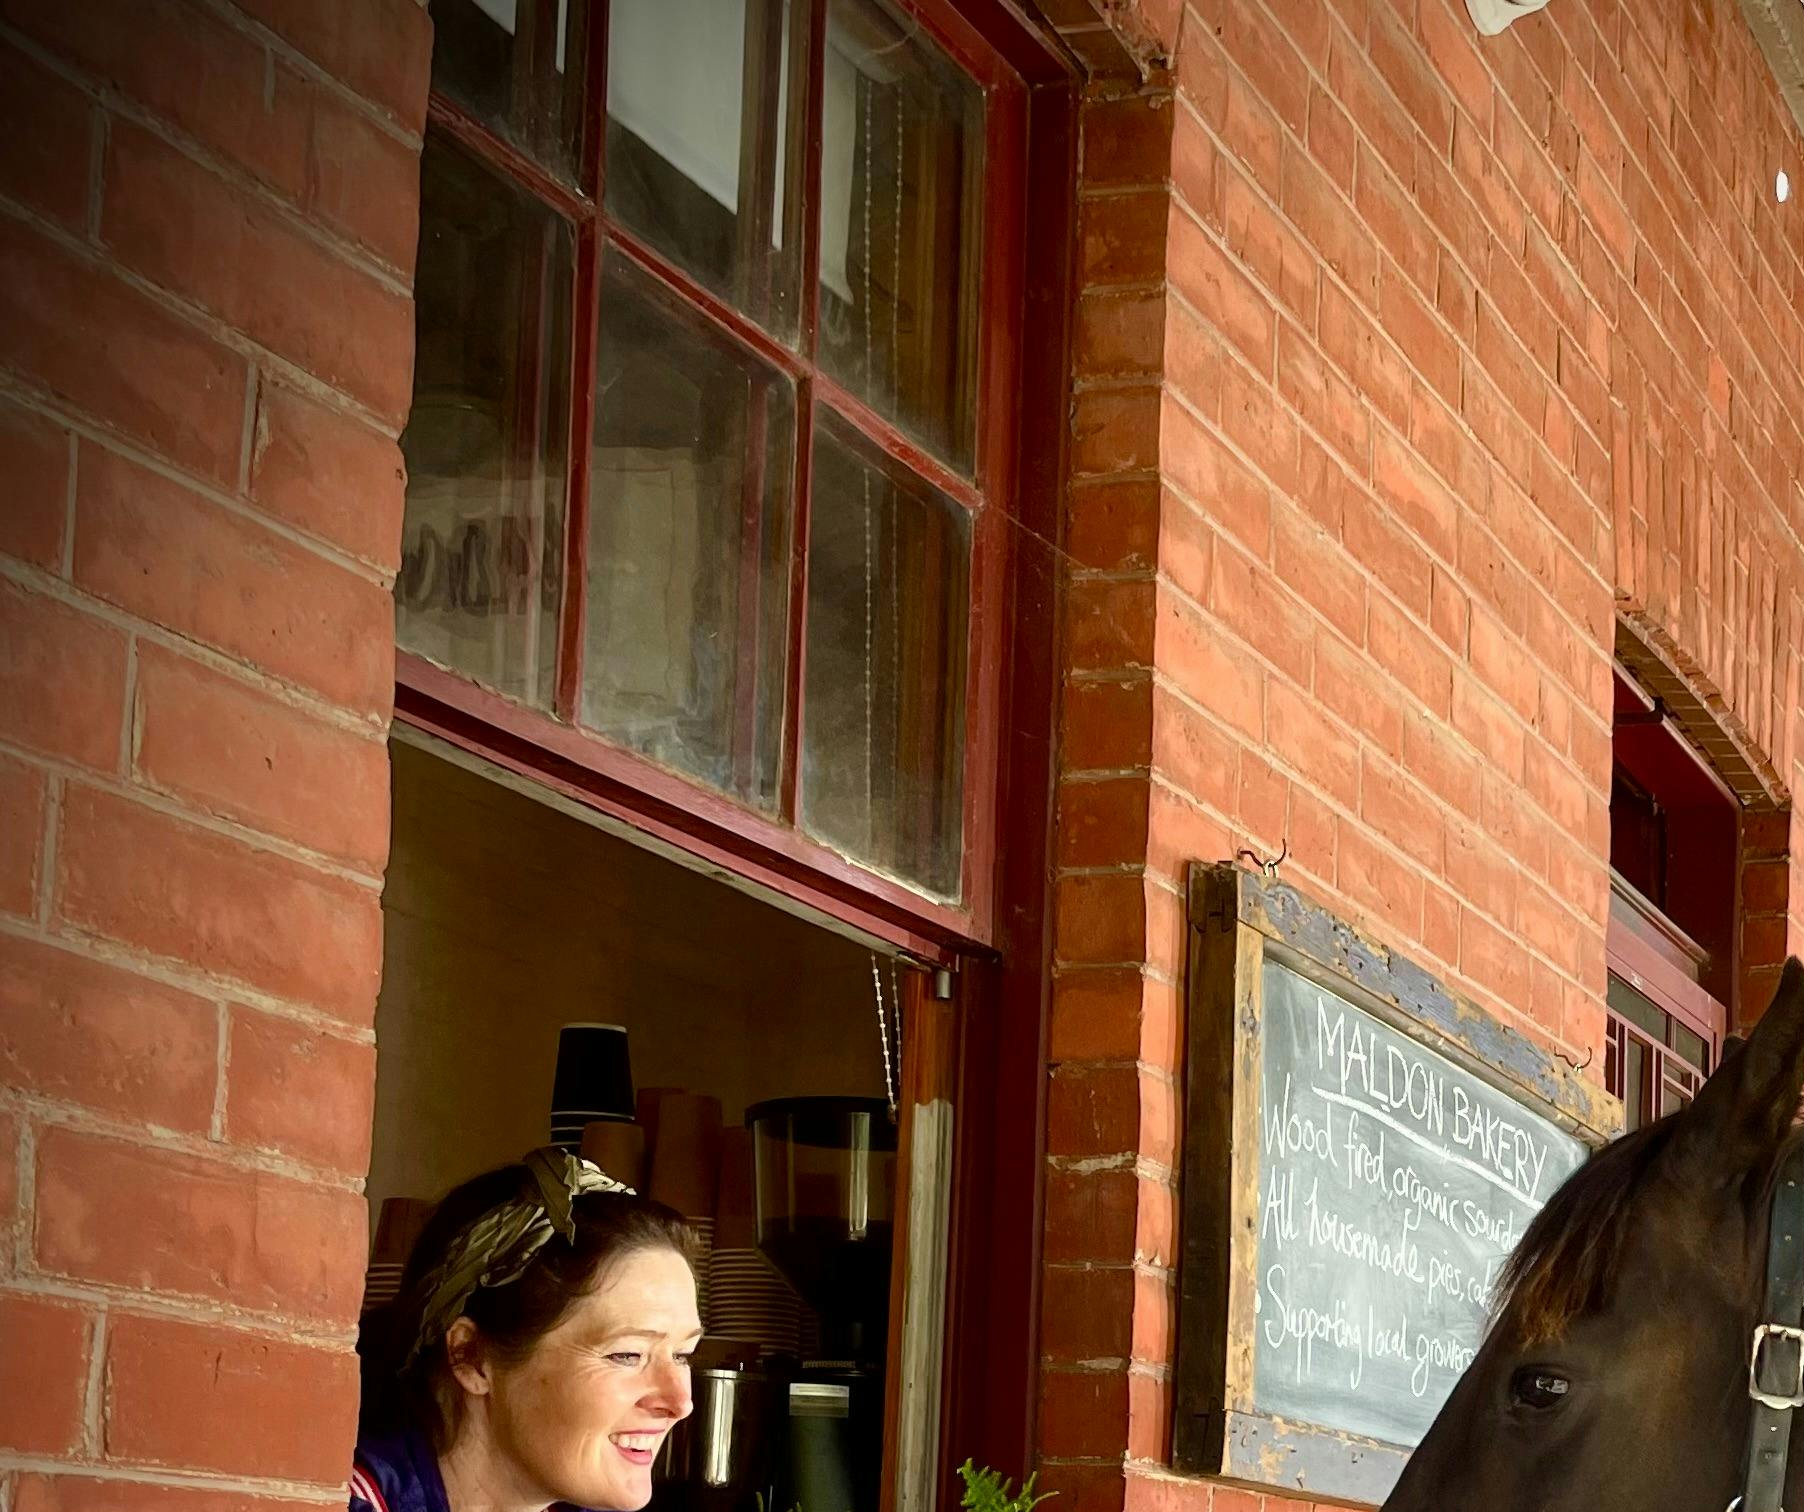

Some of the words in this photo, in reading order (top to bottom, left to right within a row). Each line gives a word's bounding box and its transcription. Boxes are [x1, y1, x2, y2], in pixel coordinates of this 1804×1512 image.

[1262, 1072, 1338, 1167] Wood
[1317, 996, 1444, 1137] MALDON
[1452, 1086, 1548, 1200] BAKERY
[1262, 1165, 1298, 1250] All
[1303, 1177, 1425, 1283] housemade
[1264, 1263, 1363, 1391] Supporting
[1368, 1304, 1411, 1361] local
